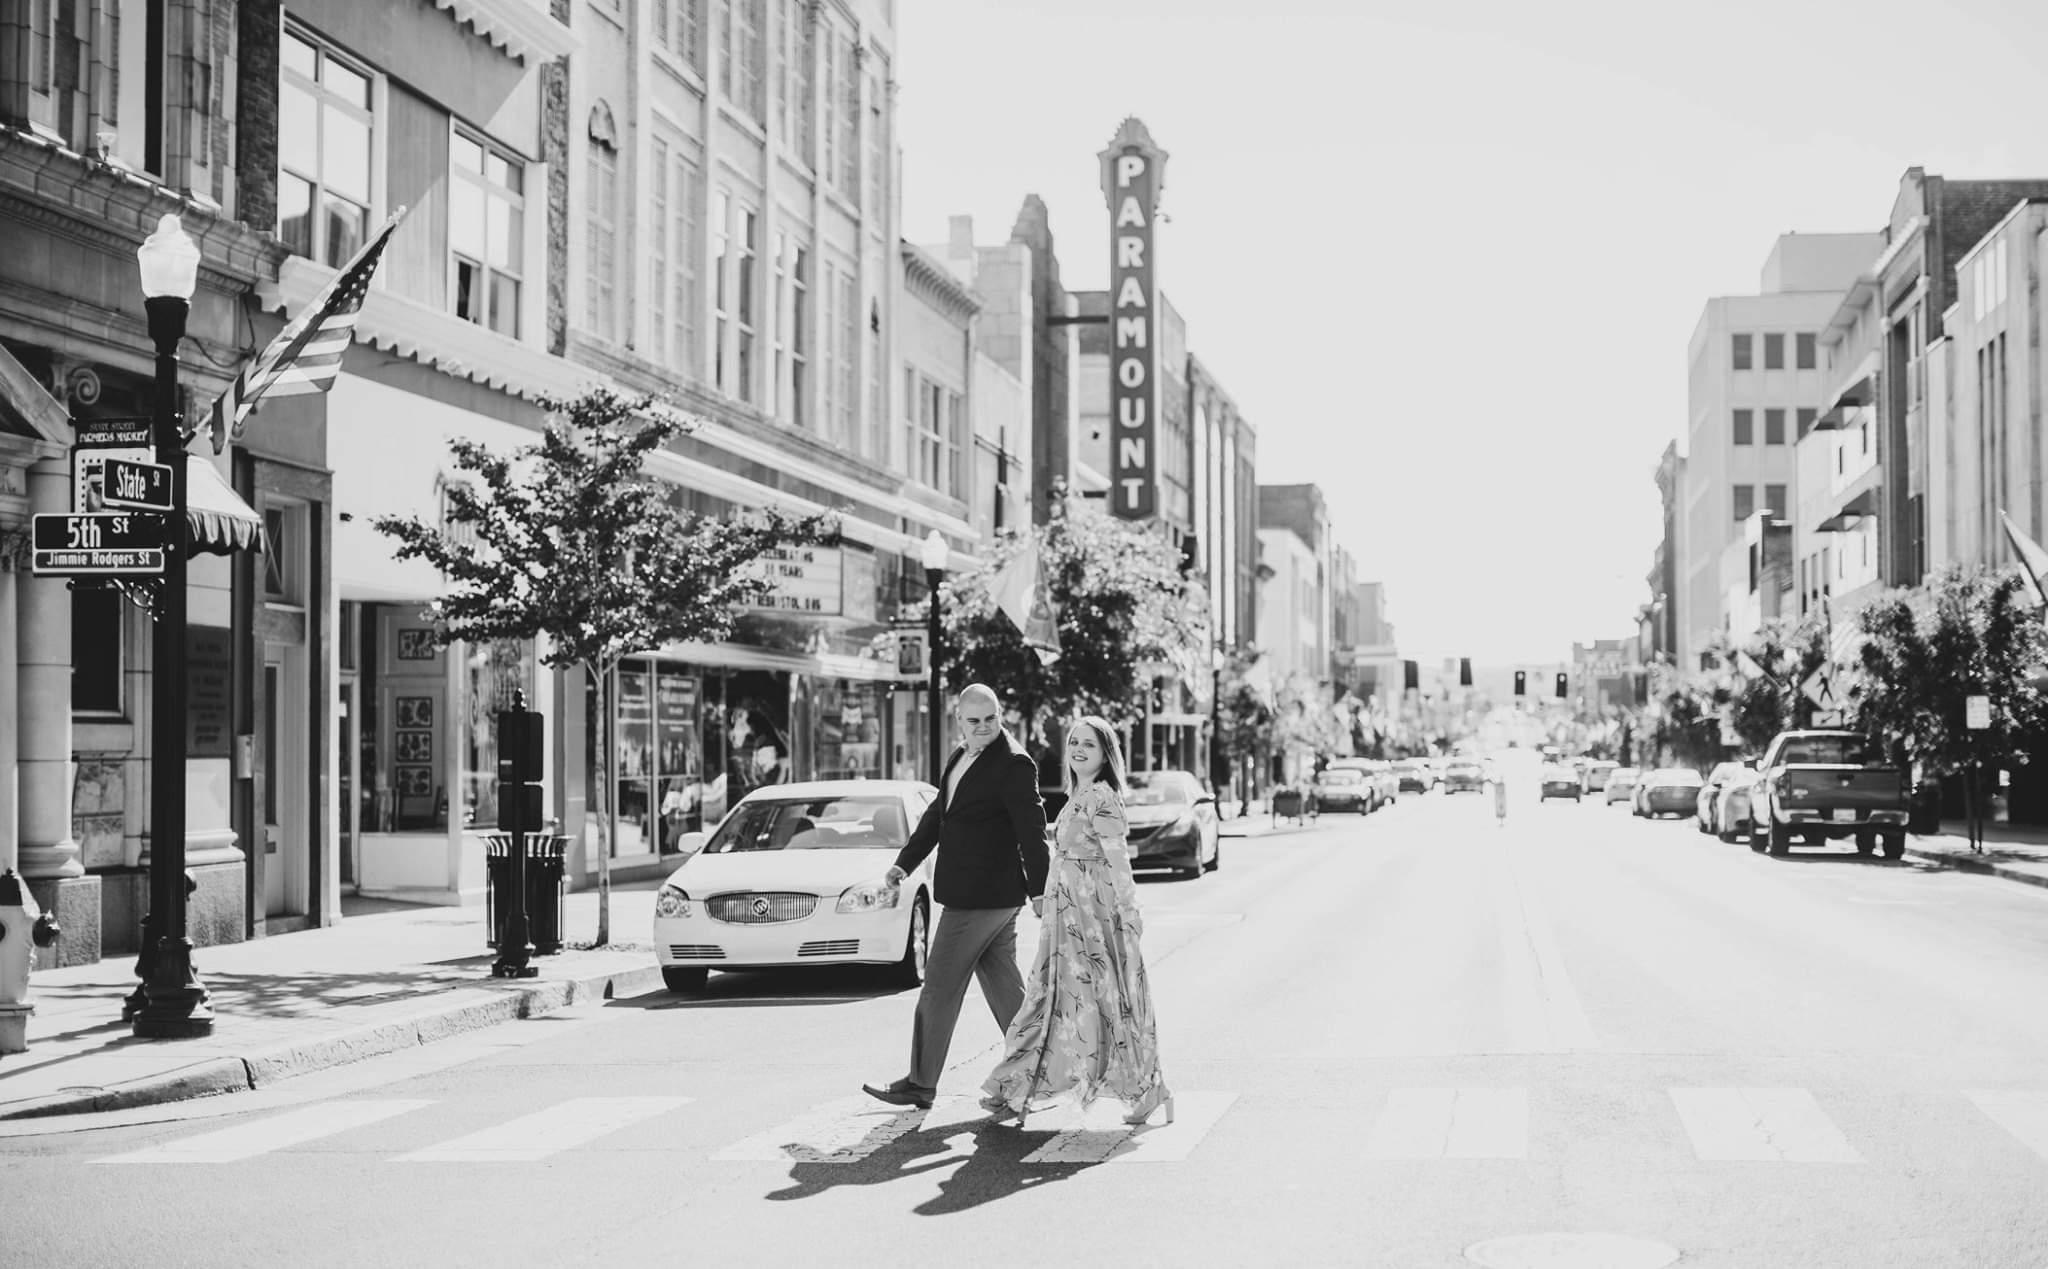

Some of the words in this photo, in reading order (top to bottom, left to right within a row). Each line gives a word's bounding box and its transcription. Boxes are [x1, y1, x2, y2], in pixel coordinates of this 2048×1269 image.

[1116, 155, 1147, 510] PARAMOUNT
[116, 464, 146, 500] State
[67, 517, 101, 549] 5th
[111, 517, 129, 534] St
[47, 551, 87, 566] Jimmie
[91, 551, 134, 568] Rodgers
[138, 551, 150, 564] St
[778, 564, 804, 578] YEARS
